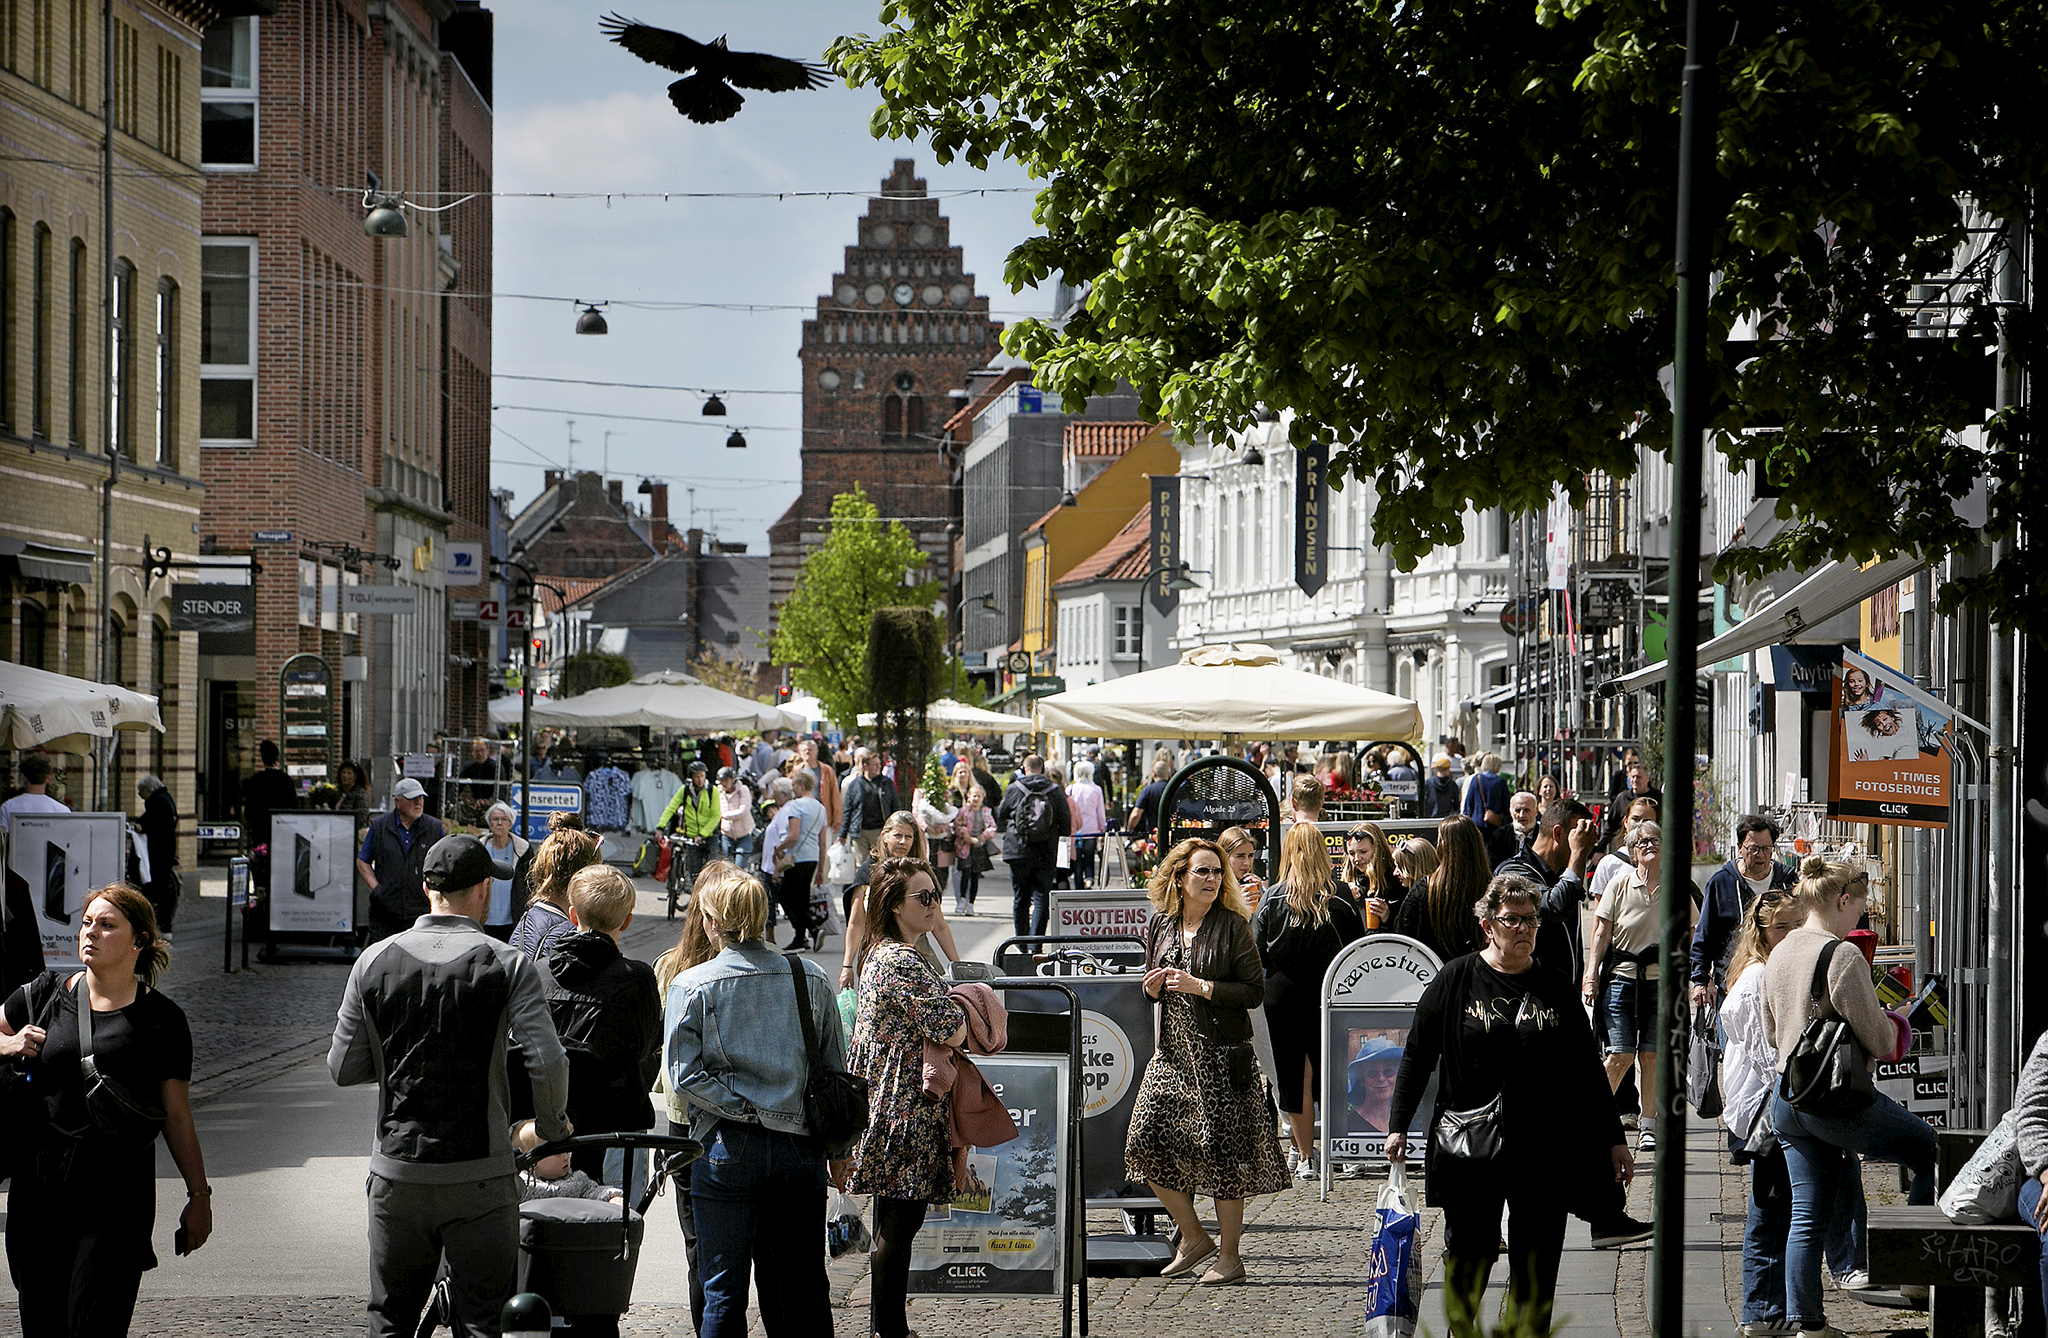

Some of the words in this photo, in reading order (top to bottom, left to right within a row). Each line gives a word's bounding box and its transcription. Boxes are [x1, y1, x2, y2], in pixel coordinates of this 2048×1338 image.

[1303, 457, 1318, 575] PRINDSEN
[1159, 491, 1171, 596] PRINDSEN
[182, 600, 241, 614] STENDER
[1893, 771, 1898, 781] 1
[1901, 772, 1941, 784] TIMES
[1855, 780, 1941, 796] FOTOSERVICE
[530, 794, 575, 805] nsrettet
[1203, 804, 1227, 814] Algade
[1227, 805, 1236, 813] 25
[1879, 803, 1909, 815] CLICK
[1324, 836, 1343, 847] OB
[1387, 833, 1414, 845] OBS
[1061, 908, 1147, 926] SKOTTENS
[1079, 925, 1150, 939] SKOMAG
[1082, 1049, 1115, 1067] kke
[1878, 1062, 1918, 1076] CLICK
[1083, 1072, 1110, 1091] op
[1332, 1139, 1359, 1154] Kig
[1365, 1143, 1385, 1155] op
[1014, 1241, 1031, 1249] time
[948, 1266, 987, 1277] CLICK
